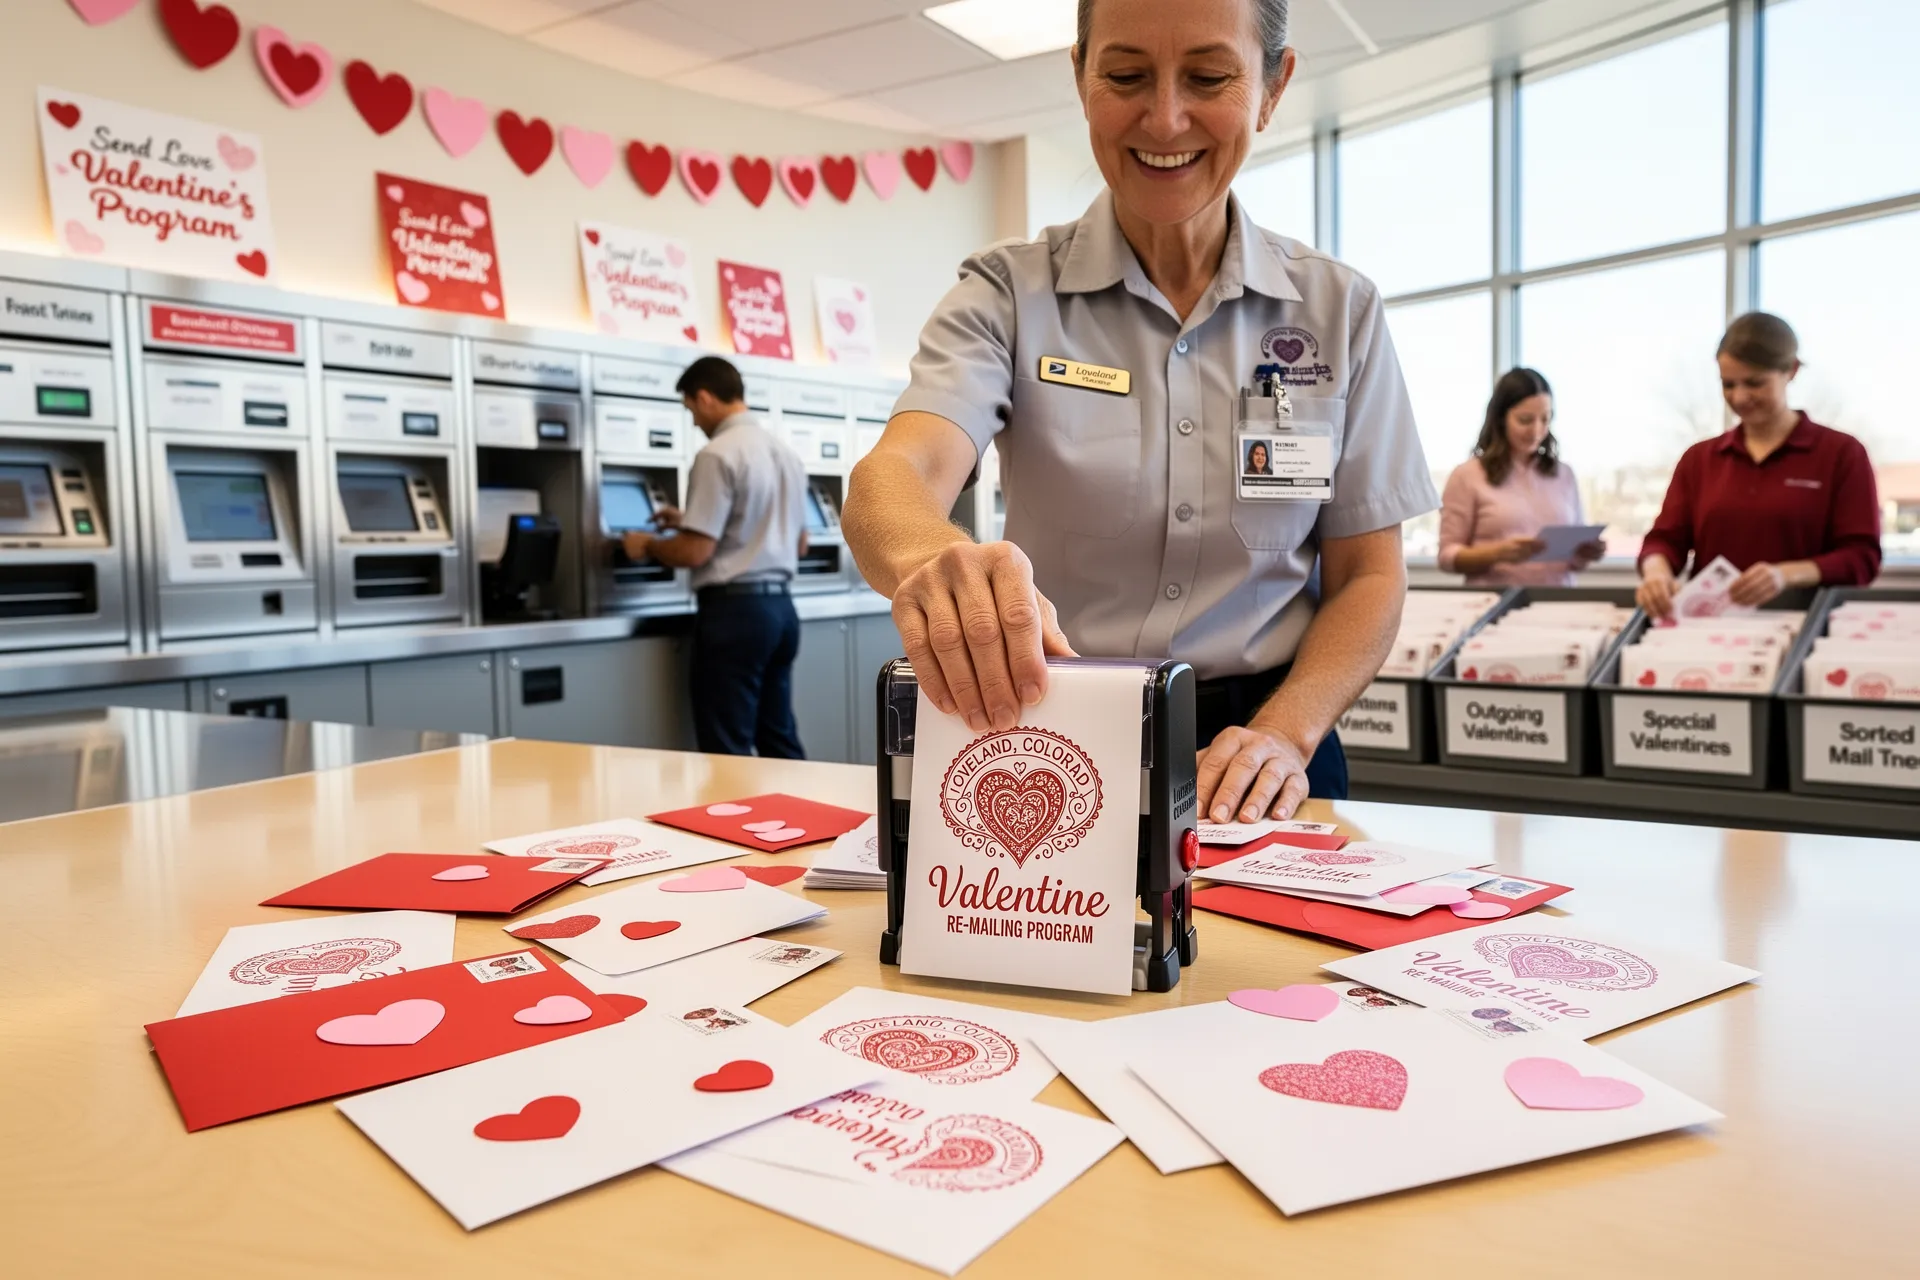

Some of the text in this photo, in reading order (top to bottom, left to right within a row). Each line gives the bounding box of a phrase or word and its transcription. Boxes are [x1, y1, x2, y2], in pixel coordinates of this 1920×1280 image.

[90, 125, 214, 171] Send Love
[70, 149, 255, 220] Valentine's
[89, 188, 242, 241] Program
[1076, 366, 1118, 381] Loveland
[1466, 701, 1544, 727] Outgoing
[1643, 709, 1717, 732] Special
[1462, 723, 1549, 745] Valentines
[1629, 732, 1732, 757] Valentines
[1839, 721, 1915, 745] Sorted
[1829, 745, 1874, 766] Mail
[928, 864, 1110, 918] Valentine
[947, 914, 1093, 944] RE-MAILING PROGRAM
[1412, 950, 1592, 1018] Valentine
